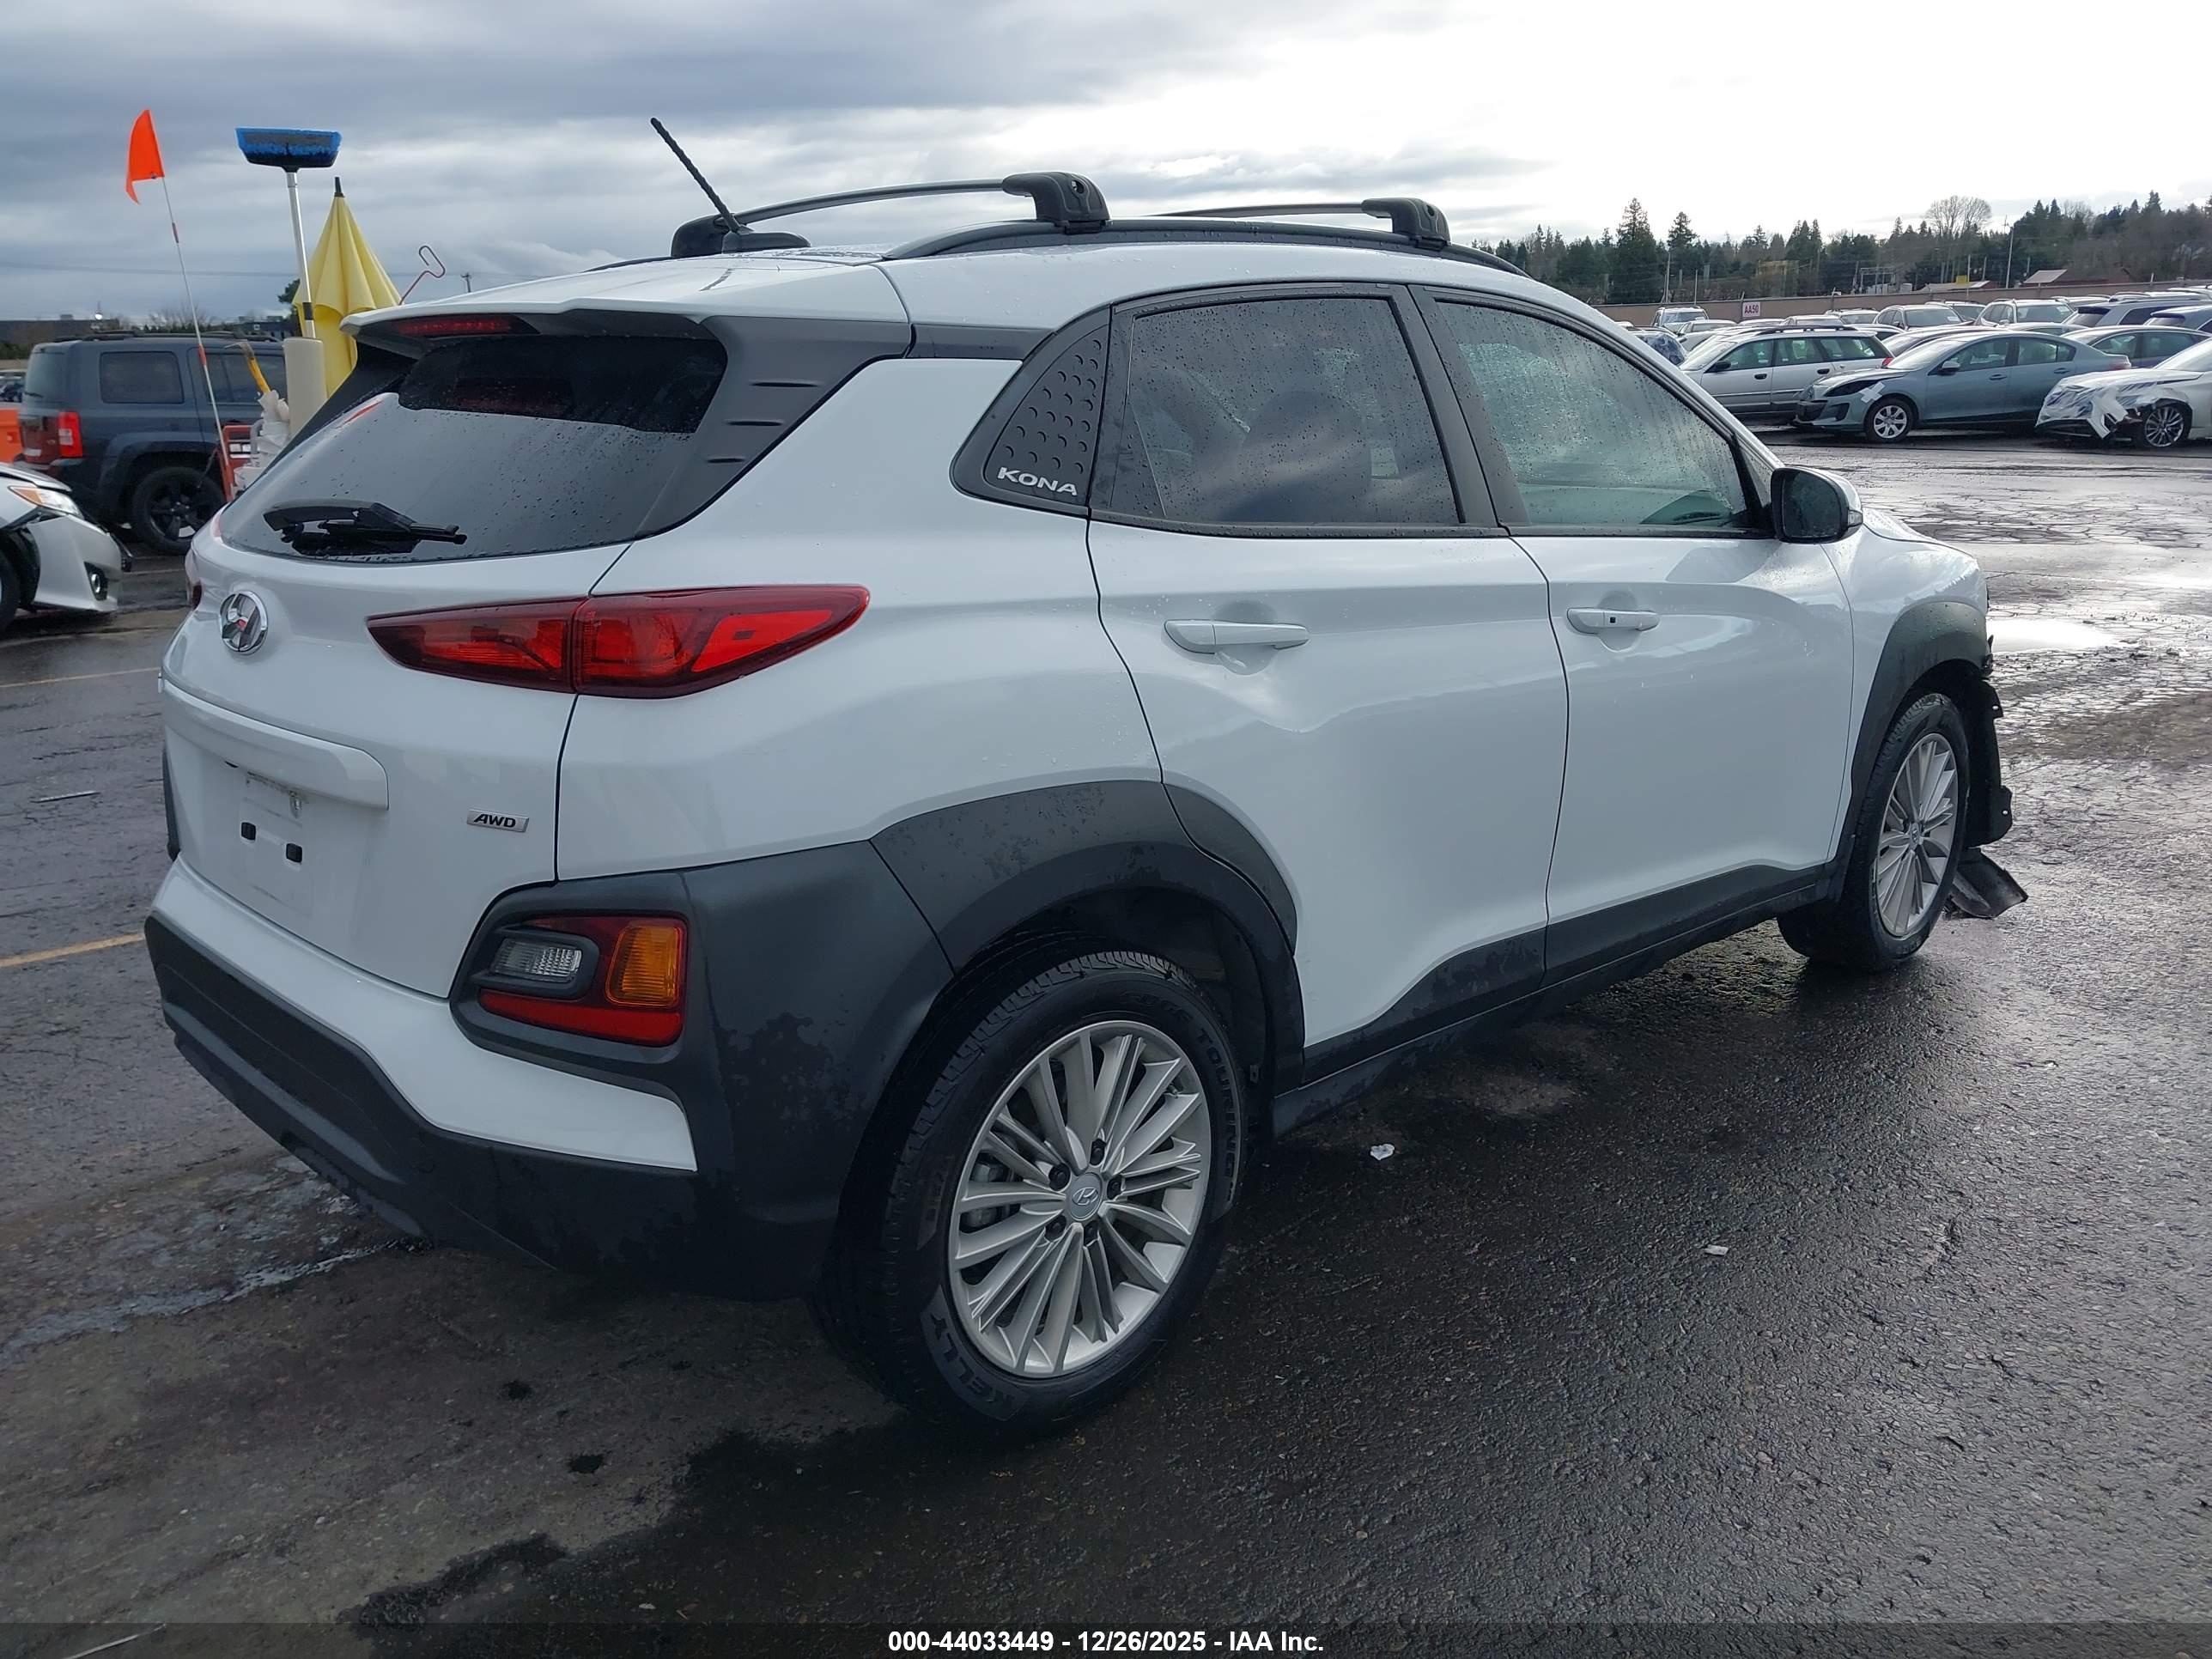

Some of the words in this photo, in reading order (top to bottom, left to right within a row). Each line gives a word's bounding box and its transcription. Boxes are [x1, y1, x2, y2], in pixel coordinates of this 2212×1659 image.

[1744, 304, 1759, 313] AA50
[997, 466, 1078, 496] KONA
[473, 813, 517, 828] AWD
